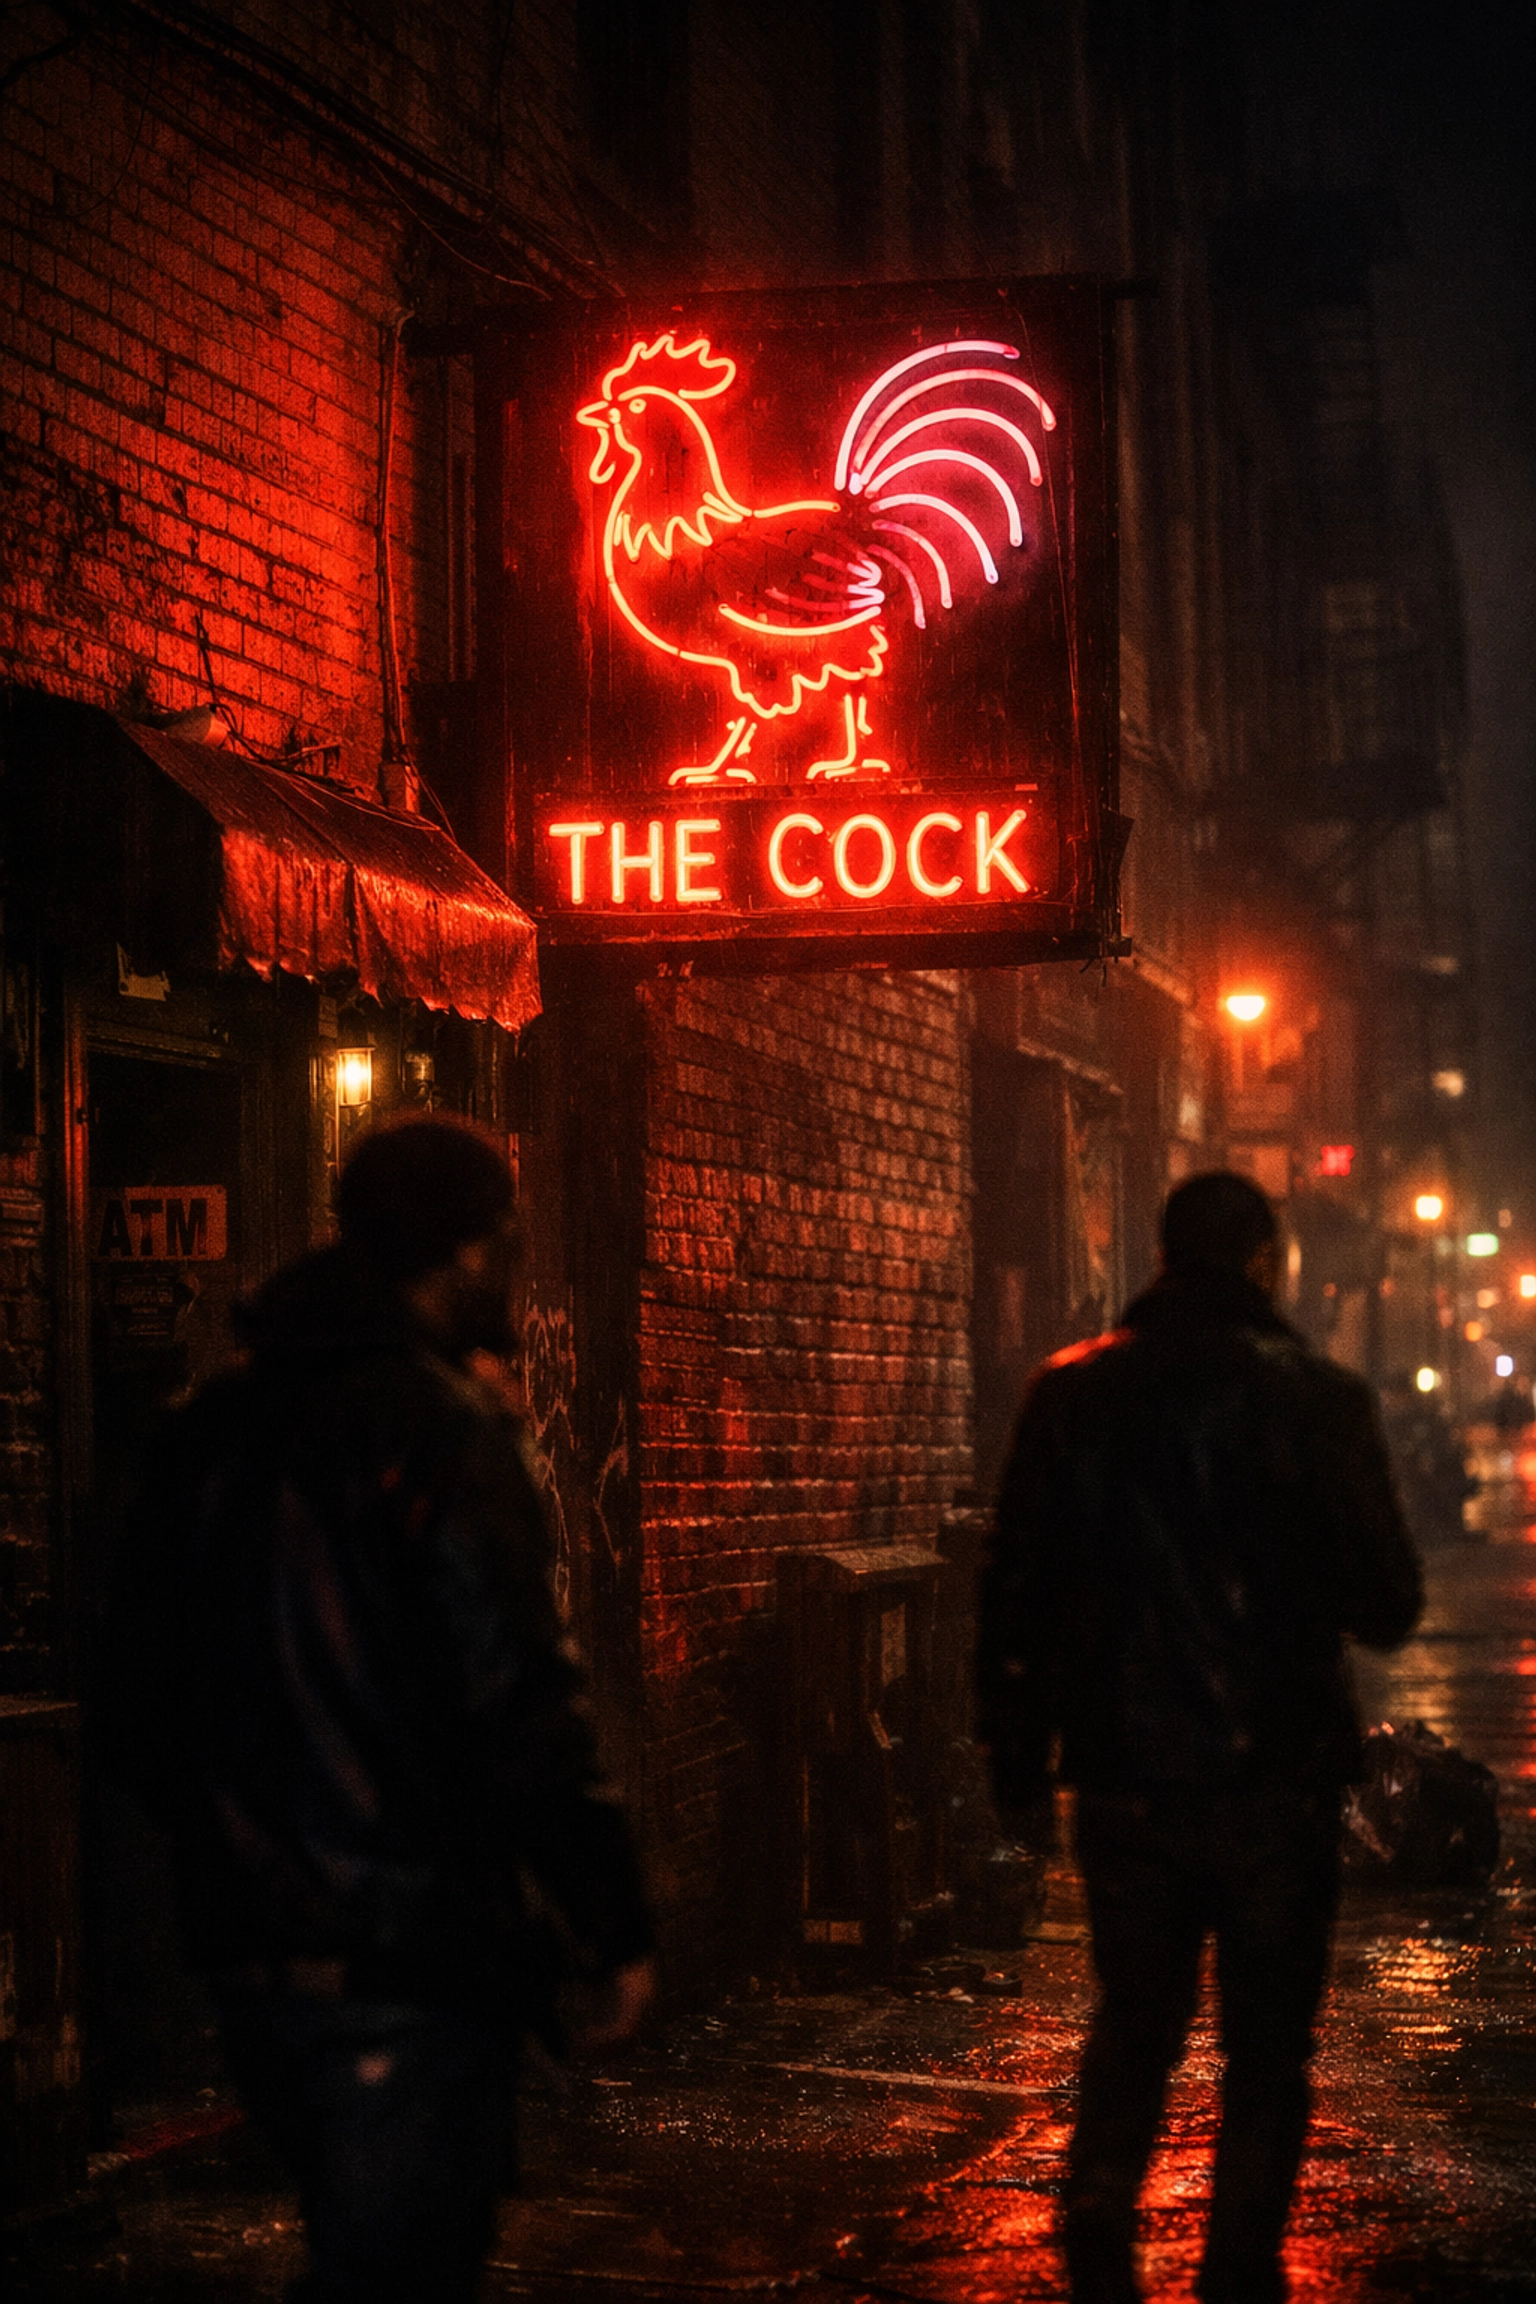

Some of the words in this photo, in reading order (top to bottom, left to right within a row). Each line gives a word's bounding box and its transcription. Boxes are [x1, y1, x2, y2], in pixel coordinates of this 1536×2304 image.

[548, 818, 722, 904] THE
[767, 808, 1030, 899] COCK
[100, 1199, 208, 1256] ATM
